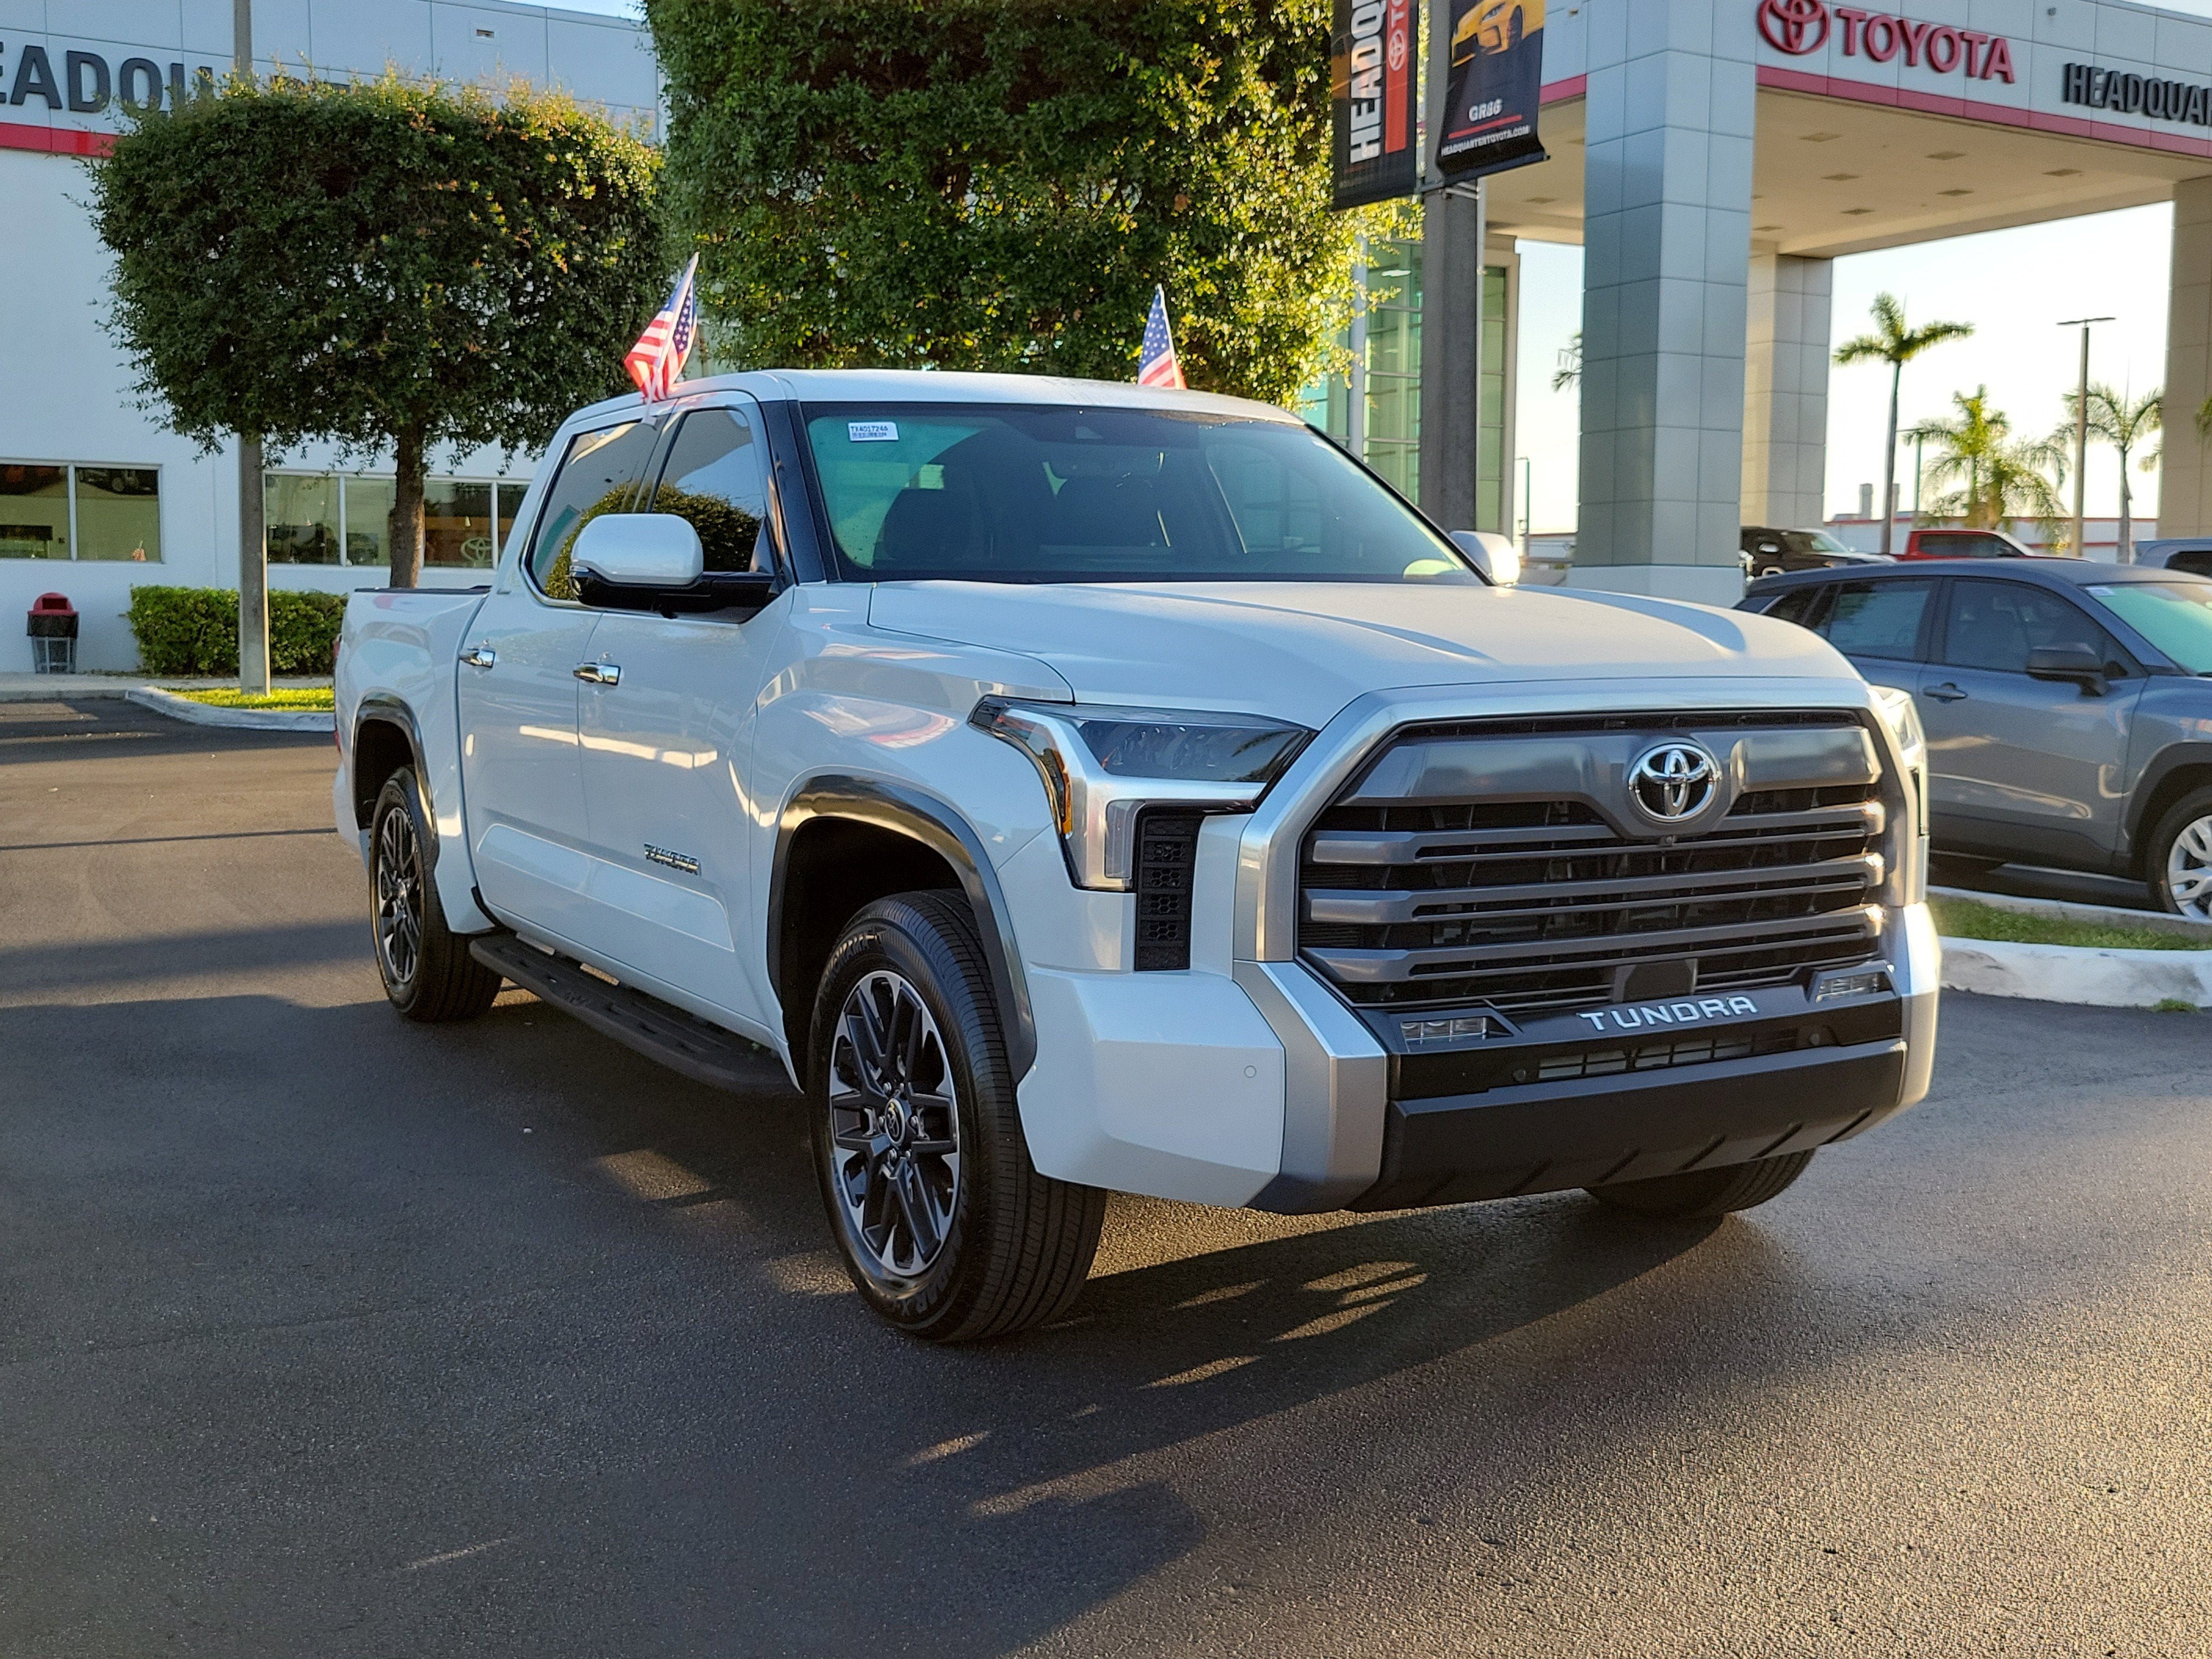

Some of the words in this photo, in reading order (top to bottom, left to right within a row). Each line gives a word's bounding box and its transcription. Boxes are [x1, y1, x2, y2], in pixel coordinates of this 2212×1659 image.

[1836, 8, 2015, 84] TOYOTA
[1350, 0, 1387, 163] HEADQ
[1469, 99, 1503, 122] GR86
[1578, 996, 1758, 1031] TUNDRA
